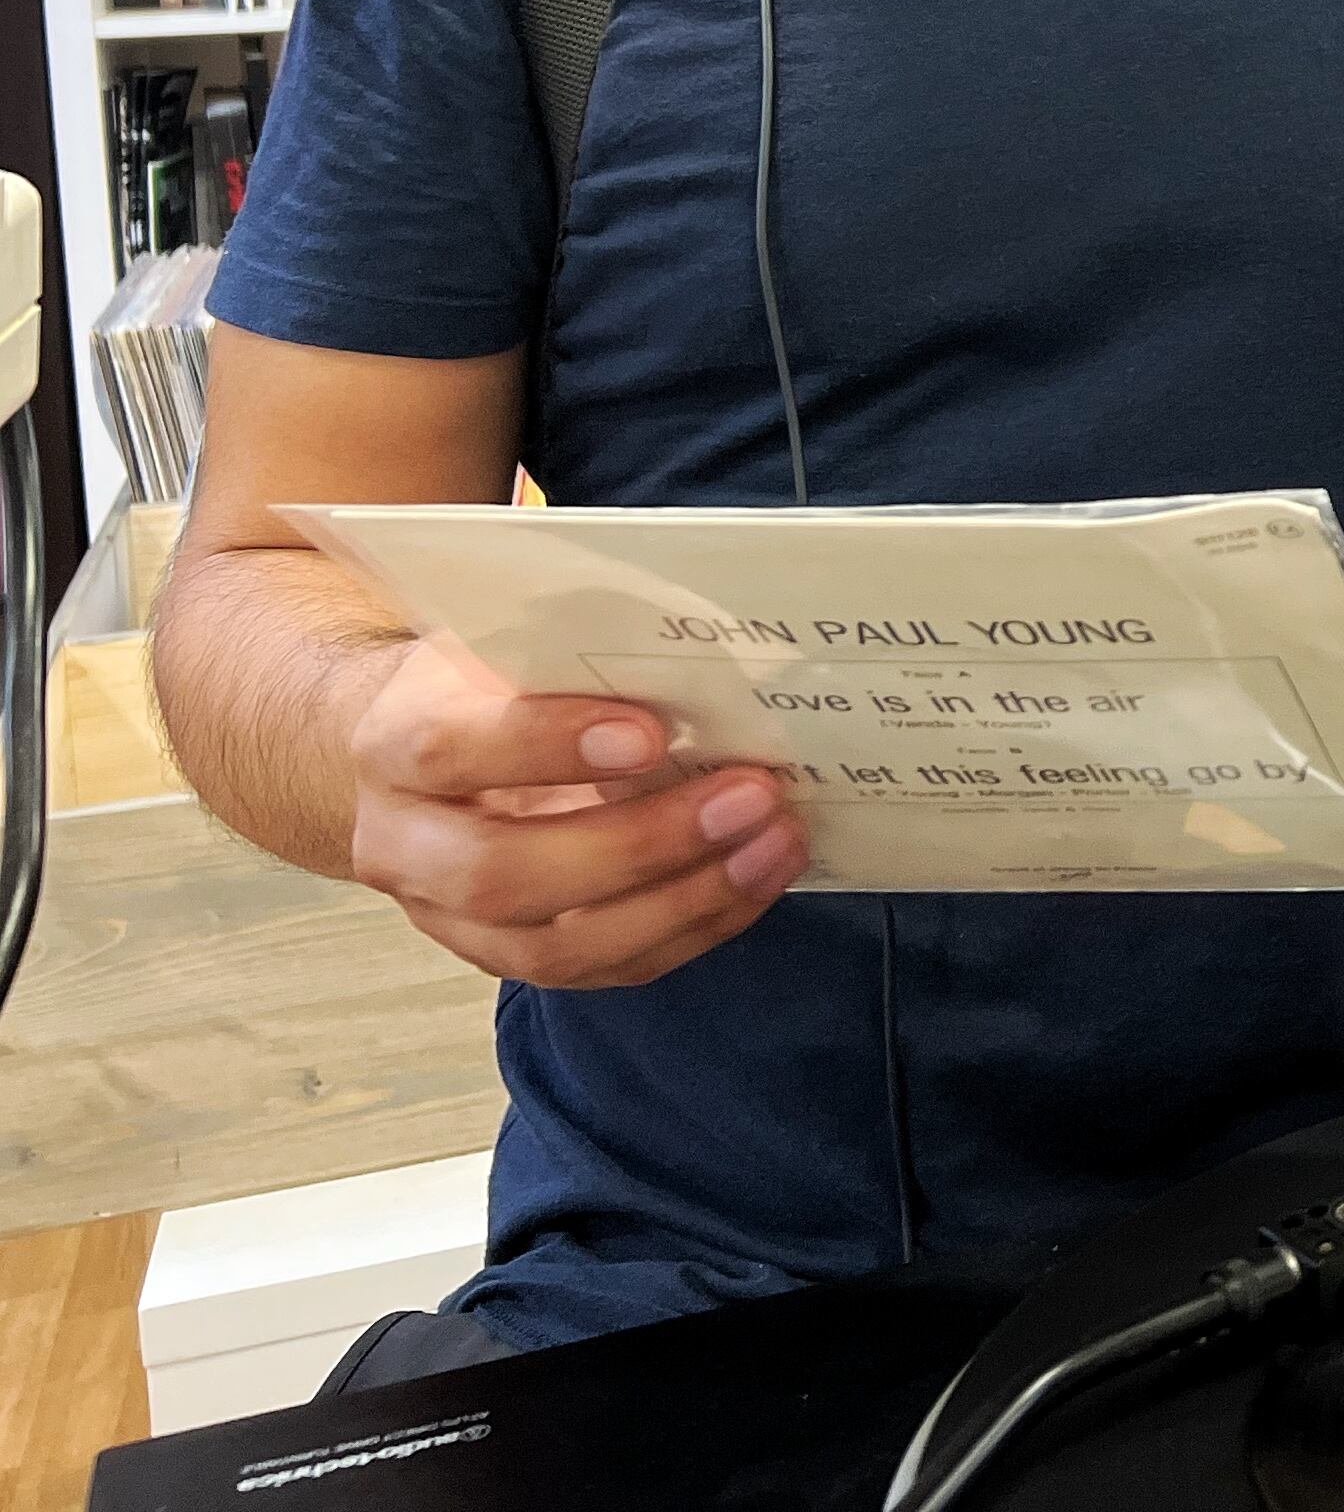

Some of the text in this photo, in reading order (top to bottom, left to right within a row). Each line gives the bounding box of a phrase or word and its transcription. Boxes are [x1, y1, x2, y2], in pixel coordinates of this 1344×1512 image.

[658, 615, 1157, 646] JOHN PAUL YOUNG
[752, 688, 1145, 714] love is in the air
[837, 762, 903, 785] let
[916, 763, 1001, 785] this
[1019, 762, 1169, 787] feeling
[1187, 764, 1243, 786] go
[1254, 759, 1308, 783] by
